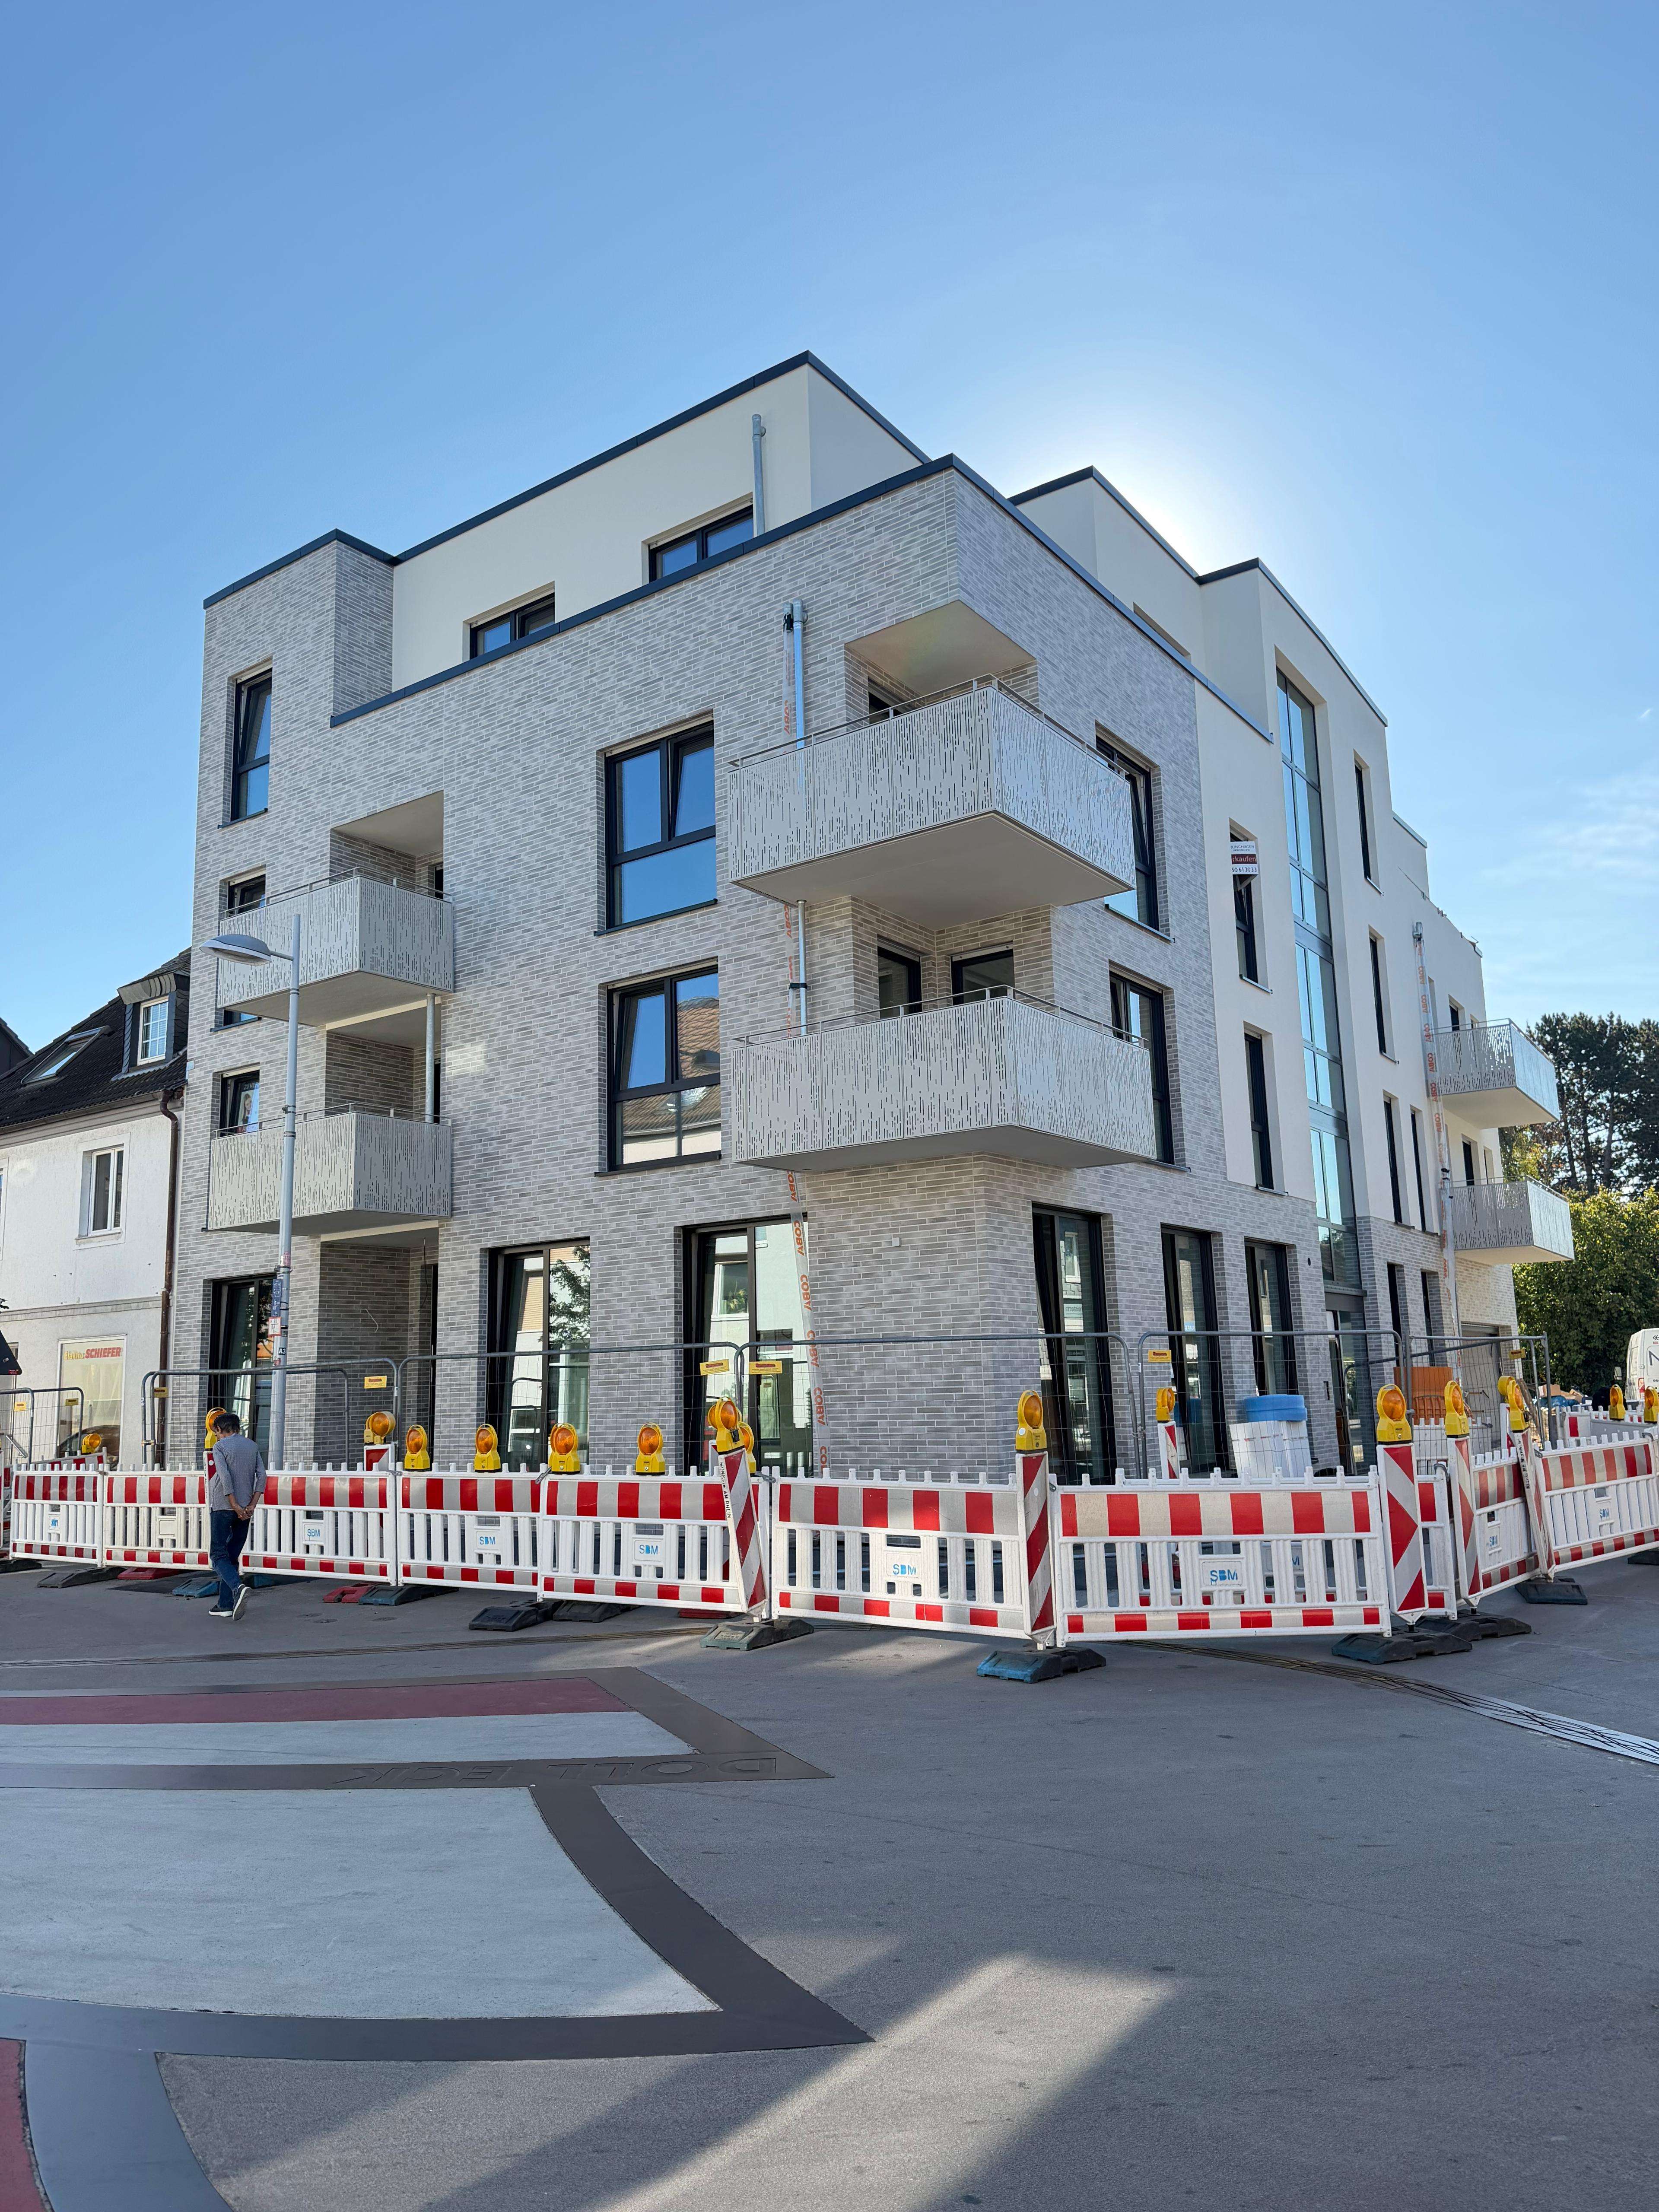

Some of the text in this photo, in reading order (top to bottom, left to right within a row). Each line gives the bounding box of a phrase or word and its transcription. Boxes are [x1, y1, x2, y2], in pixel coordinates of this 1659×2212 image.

[793, 1220, 805, 1257] COBA
[800, 1274, 812, 1311] COBA
[85, 1347, 121, 1359] SCHIEFER
[814, 1387, 826, 1426] COBA
[307, 1529, 320, 1537] SBM
[480, 1536, 496, 1545] SBM
[639, 1545, 658, 1555] SBM
[893, 1564, 916, 1575] SBM
[1210, 1569, 1238, 1583] SBM
